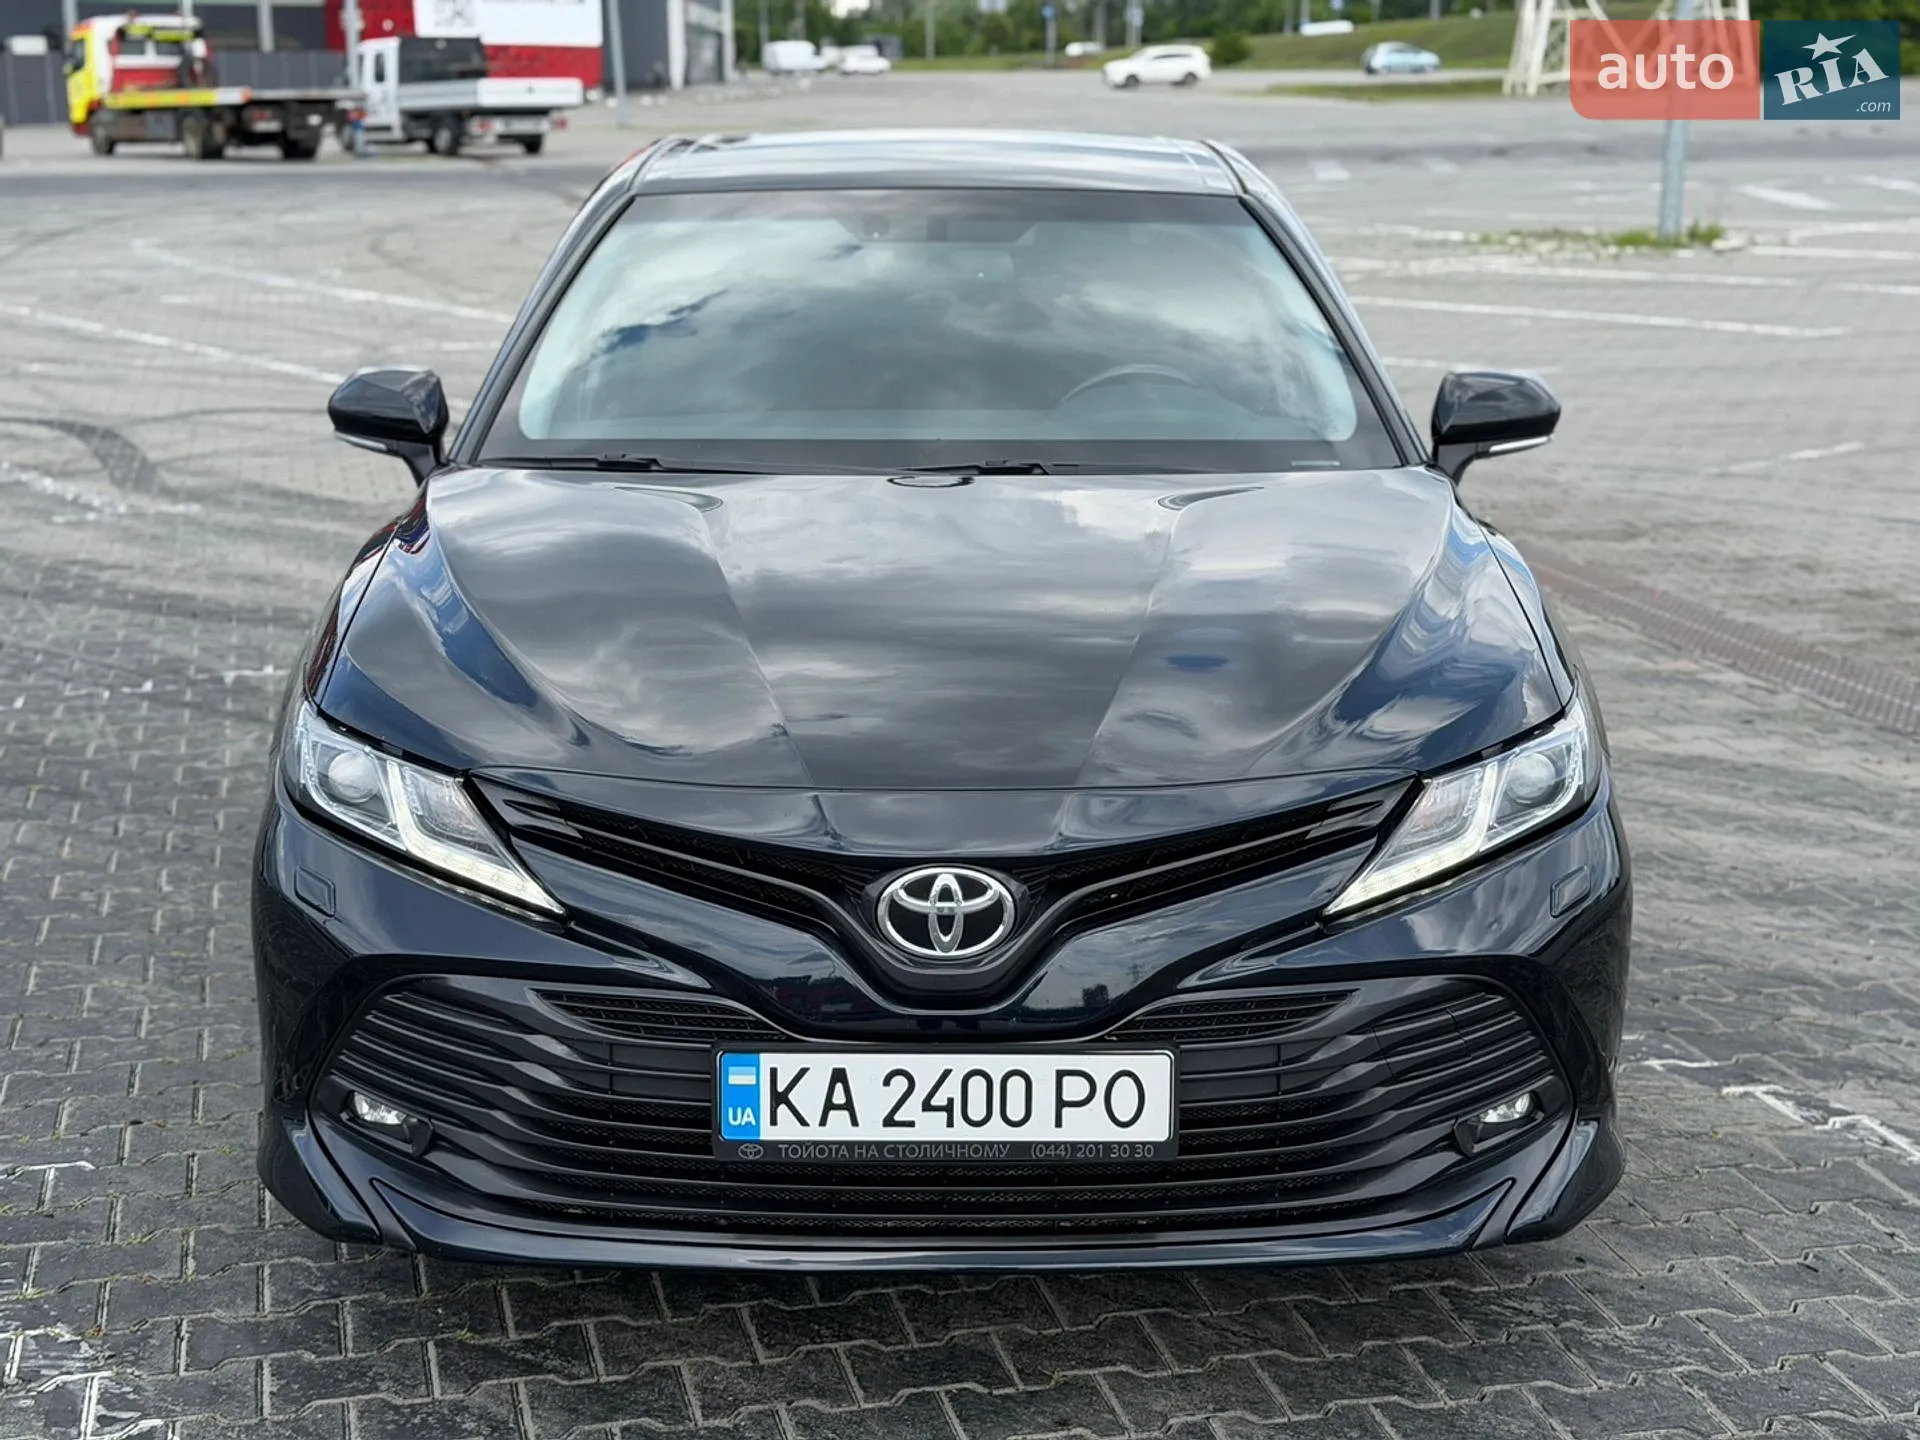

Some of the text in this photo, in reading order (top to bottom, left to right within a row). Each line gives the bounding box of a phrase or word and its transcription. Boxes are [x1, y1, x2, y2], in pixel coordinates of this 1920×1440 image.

[769, 1067, 1147, 1128] KA 2400 PO
[728, 1107, 756, 1126] UA
[778, 1142, 1154, 1159] ТОЙОТА НА СТОЛИЧНОМУ (044) 201 30 30
